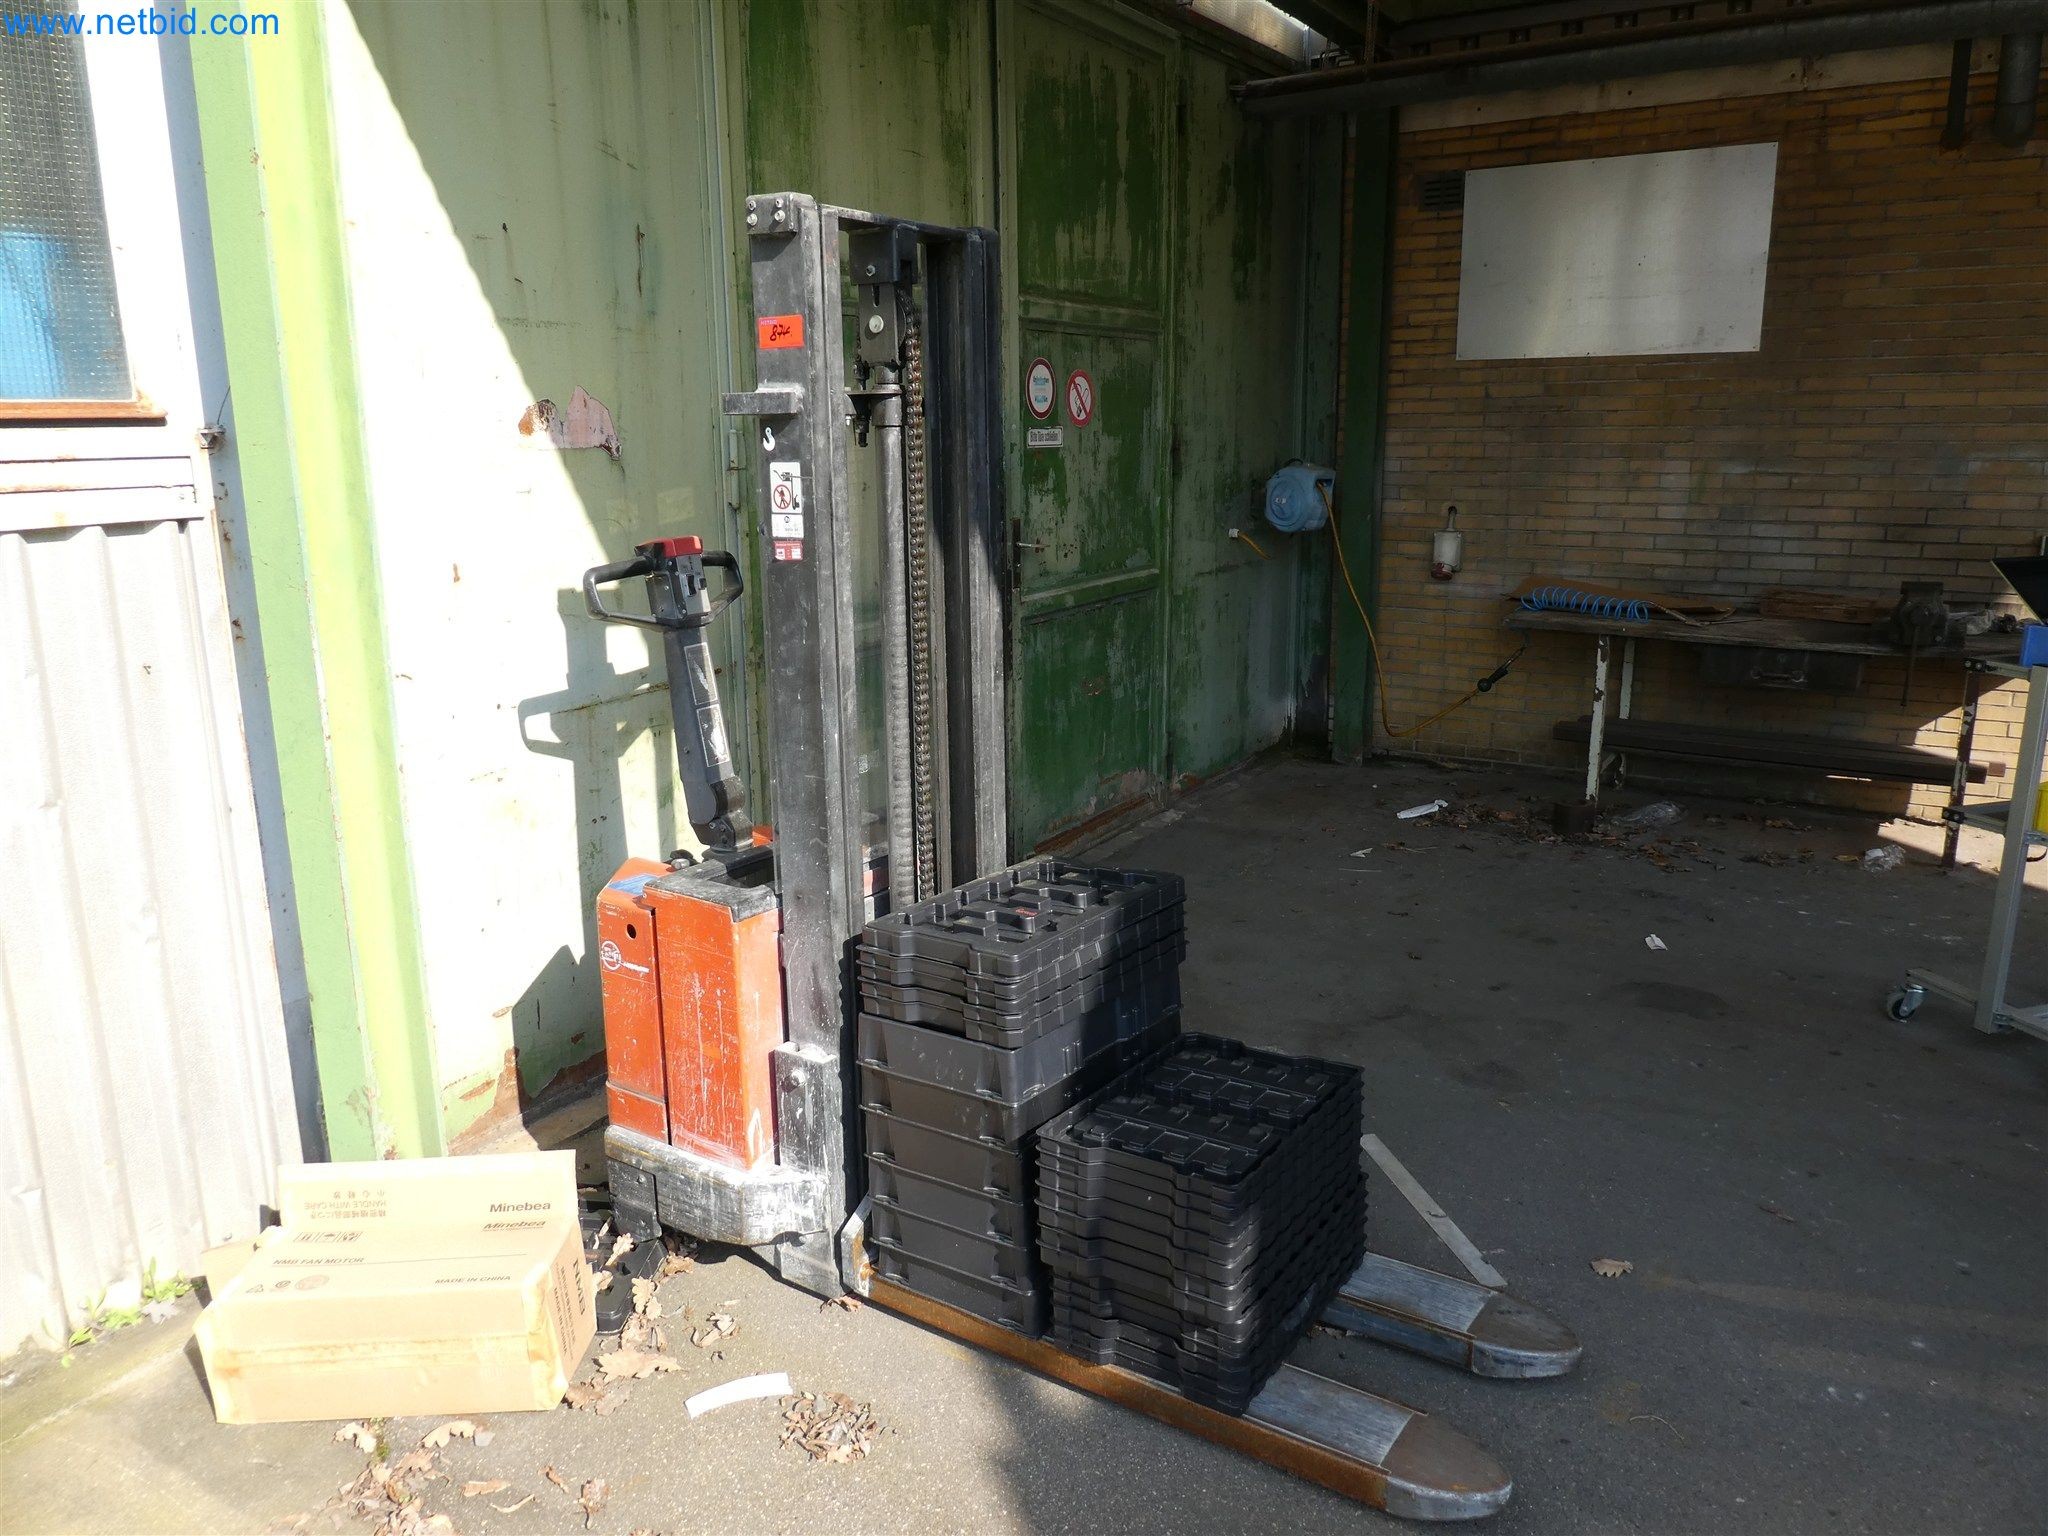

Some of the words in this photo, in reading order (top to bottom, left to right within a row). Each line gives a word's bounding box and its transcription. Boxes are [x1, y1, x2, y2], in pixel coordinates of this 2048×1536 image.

[489, 1202, 551, 1213] Minebea
[482, 1220, 546, 1230] Minebea
[324, 1257, 364, 1265] MOTOR
[573, 1258, 585, 1315] NMB
